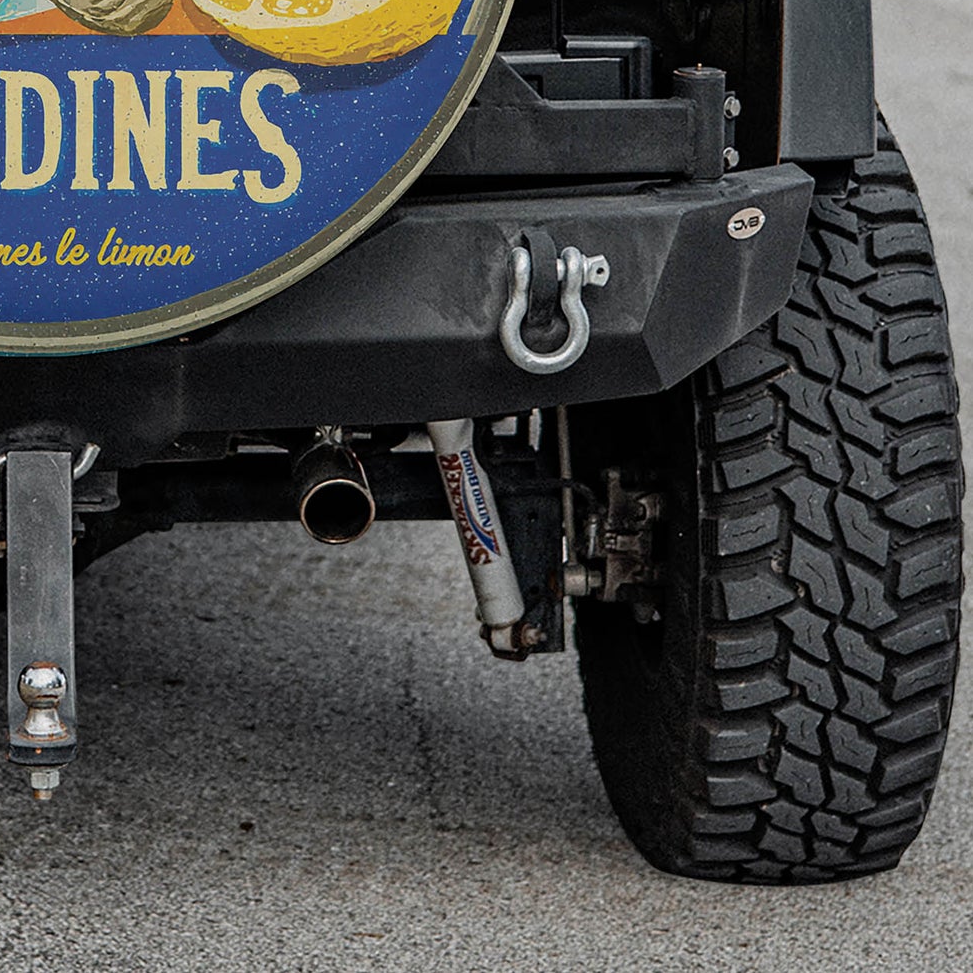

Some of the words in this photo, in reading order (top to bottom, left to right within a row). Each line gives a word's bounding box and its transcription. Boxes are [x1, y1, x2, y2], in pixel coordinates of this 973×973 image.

[55, 227, 89, 266] le
[460, 450, 480, 487] 8000
[439, 453, 492, 565] SKYJACKER
[471, 487, 494, 529] NITRO
